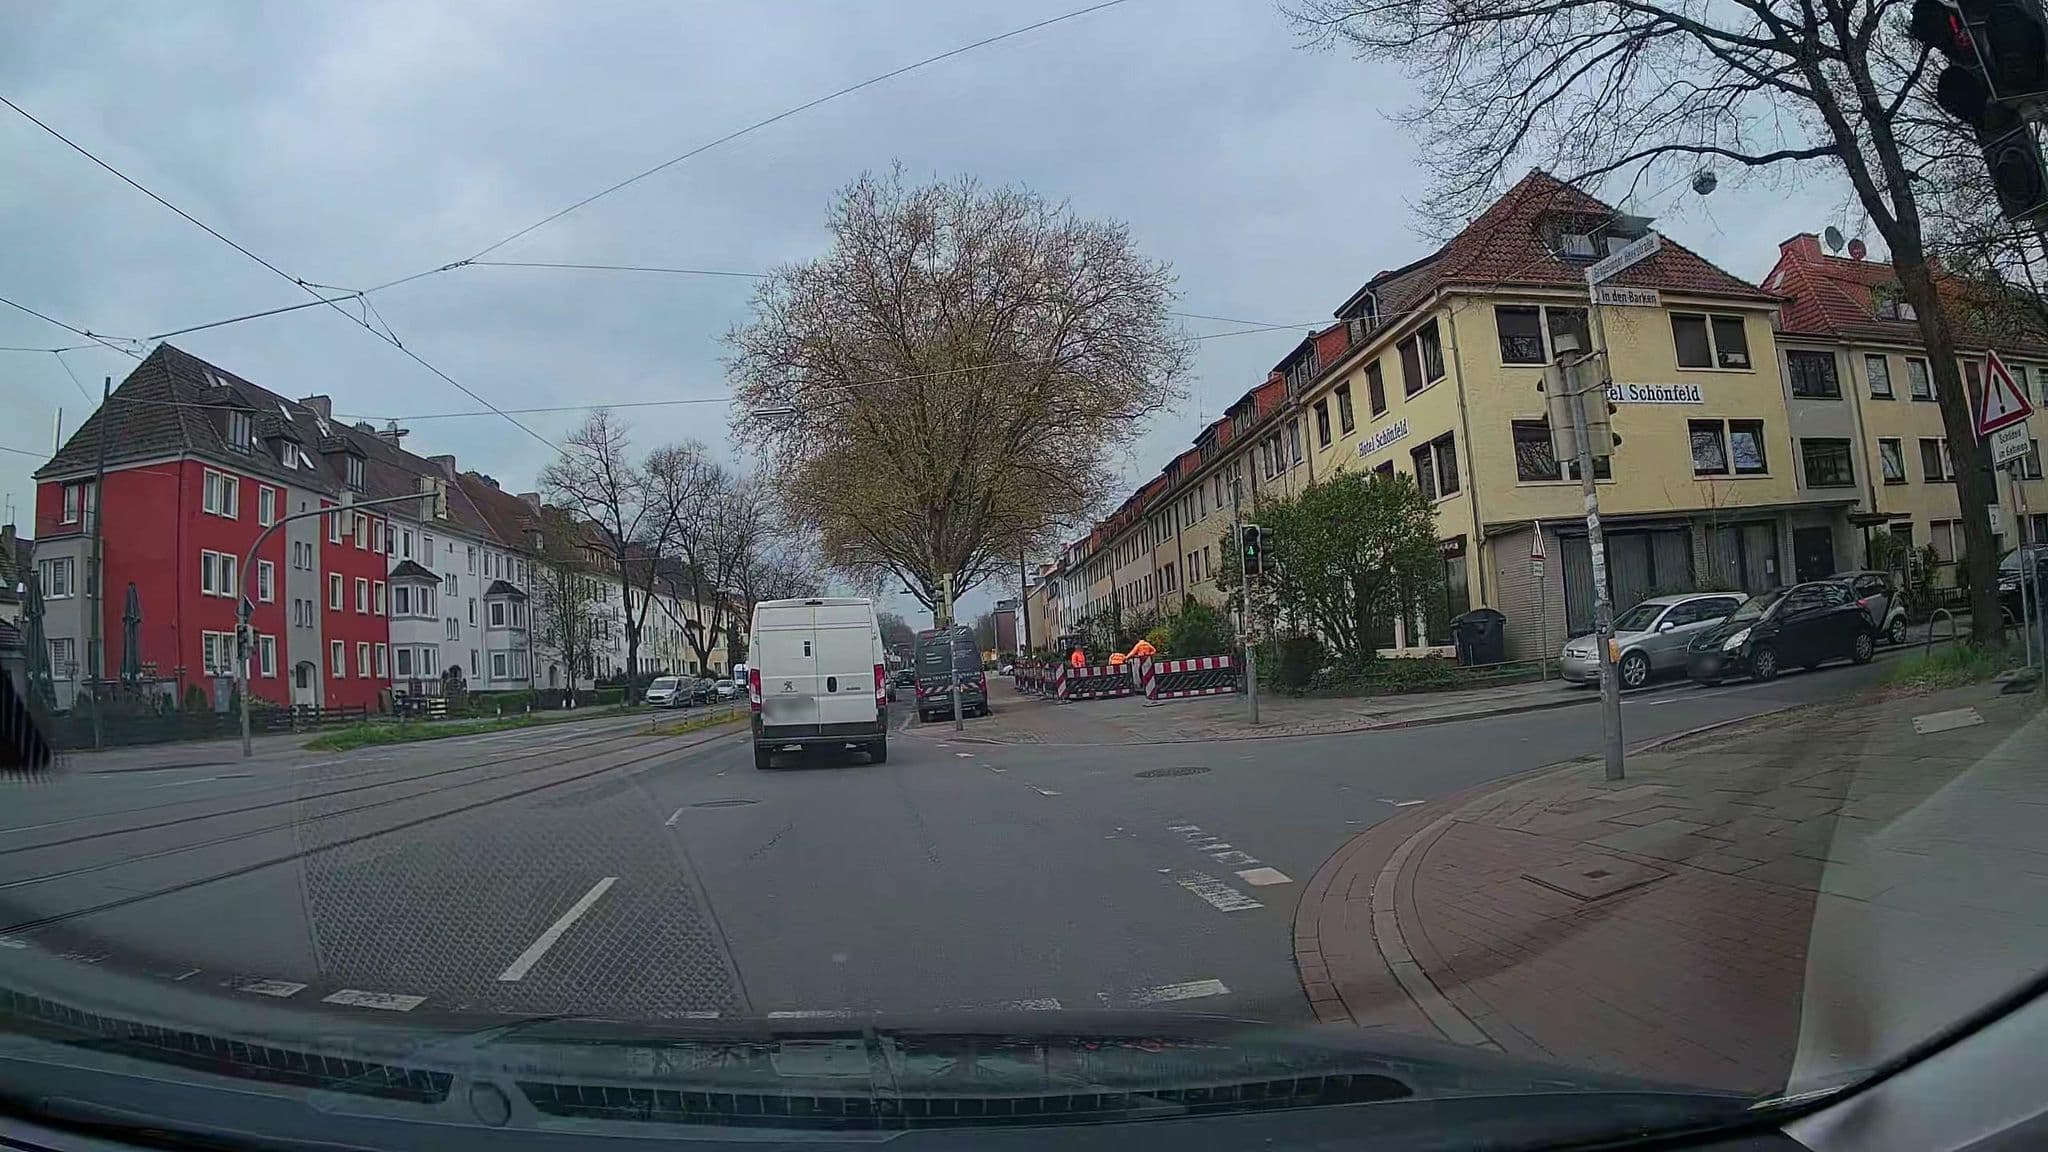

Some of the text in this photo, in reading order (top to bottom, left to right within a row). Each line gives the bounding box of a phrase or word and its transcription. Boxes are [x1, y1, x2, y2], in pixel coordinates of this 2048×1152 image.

[1601, 290, 1657, 305] In den Barken
[1605, 384, 1701, 402] tel Schönfeld
[1358, 418, 1408, 457] Hotel Schönfeld
